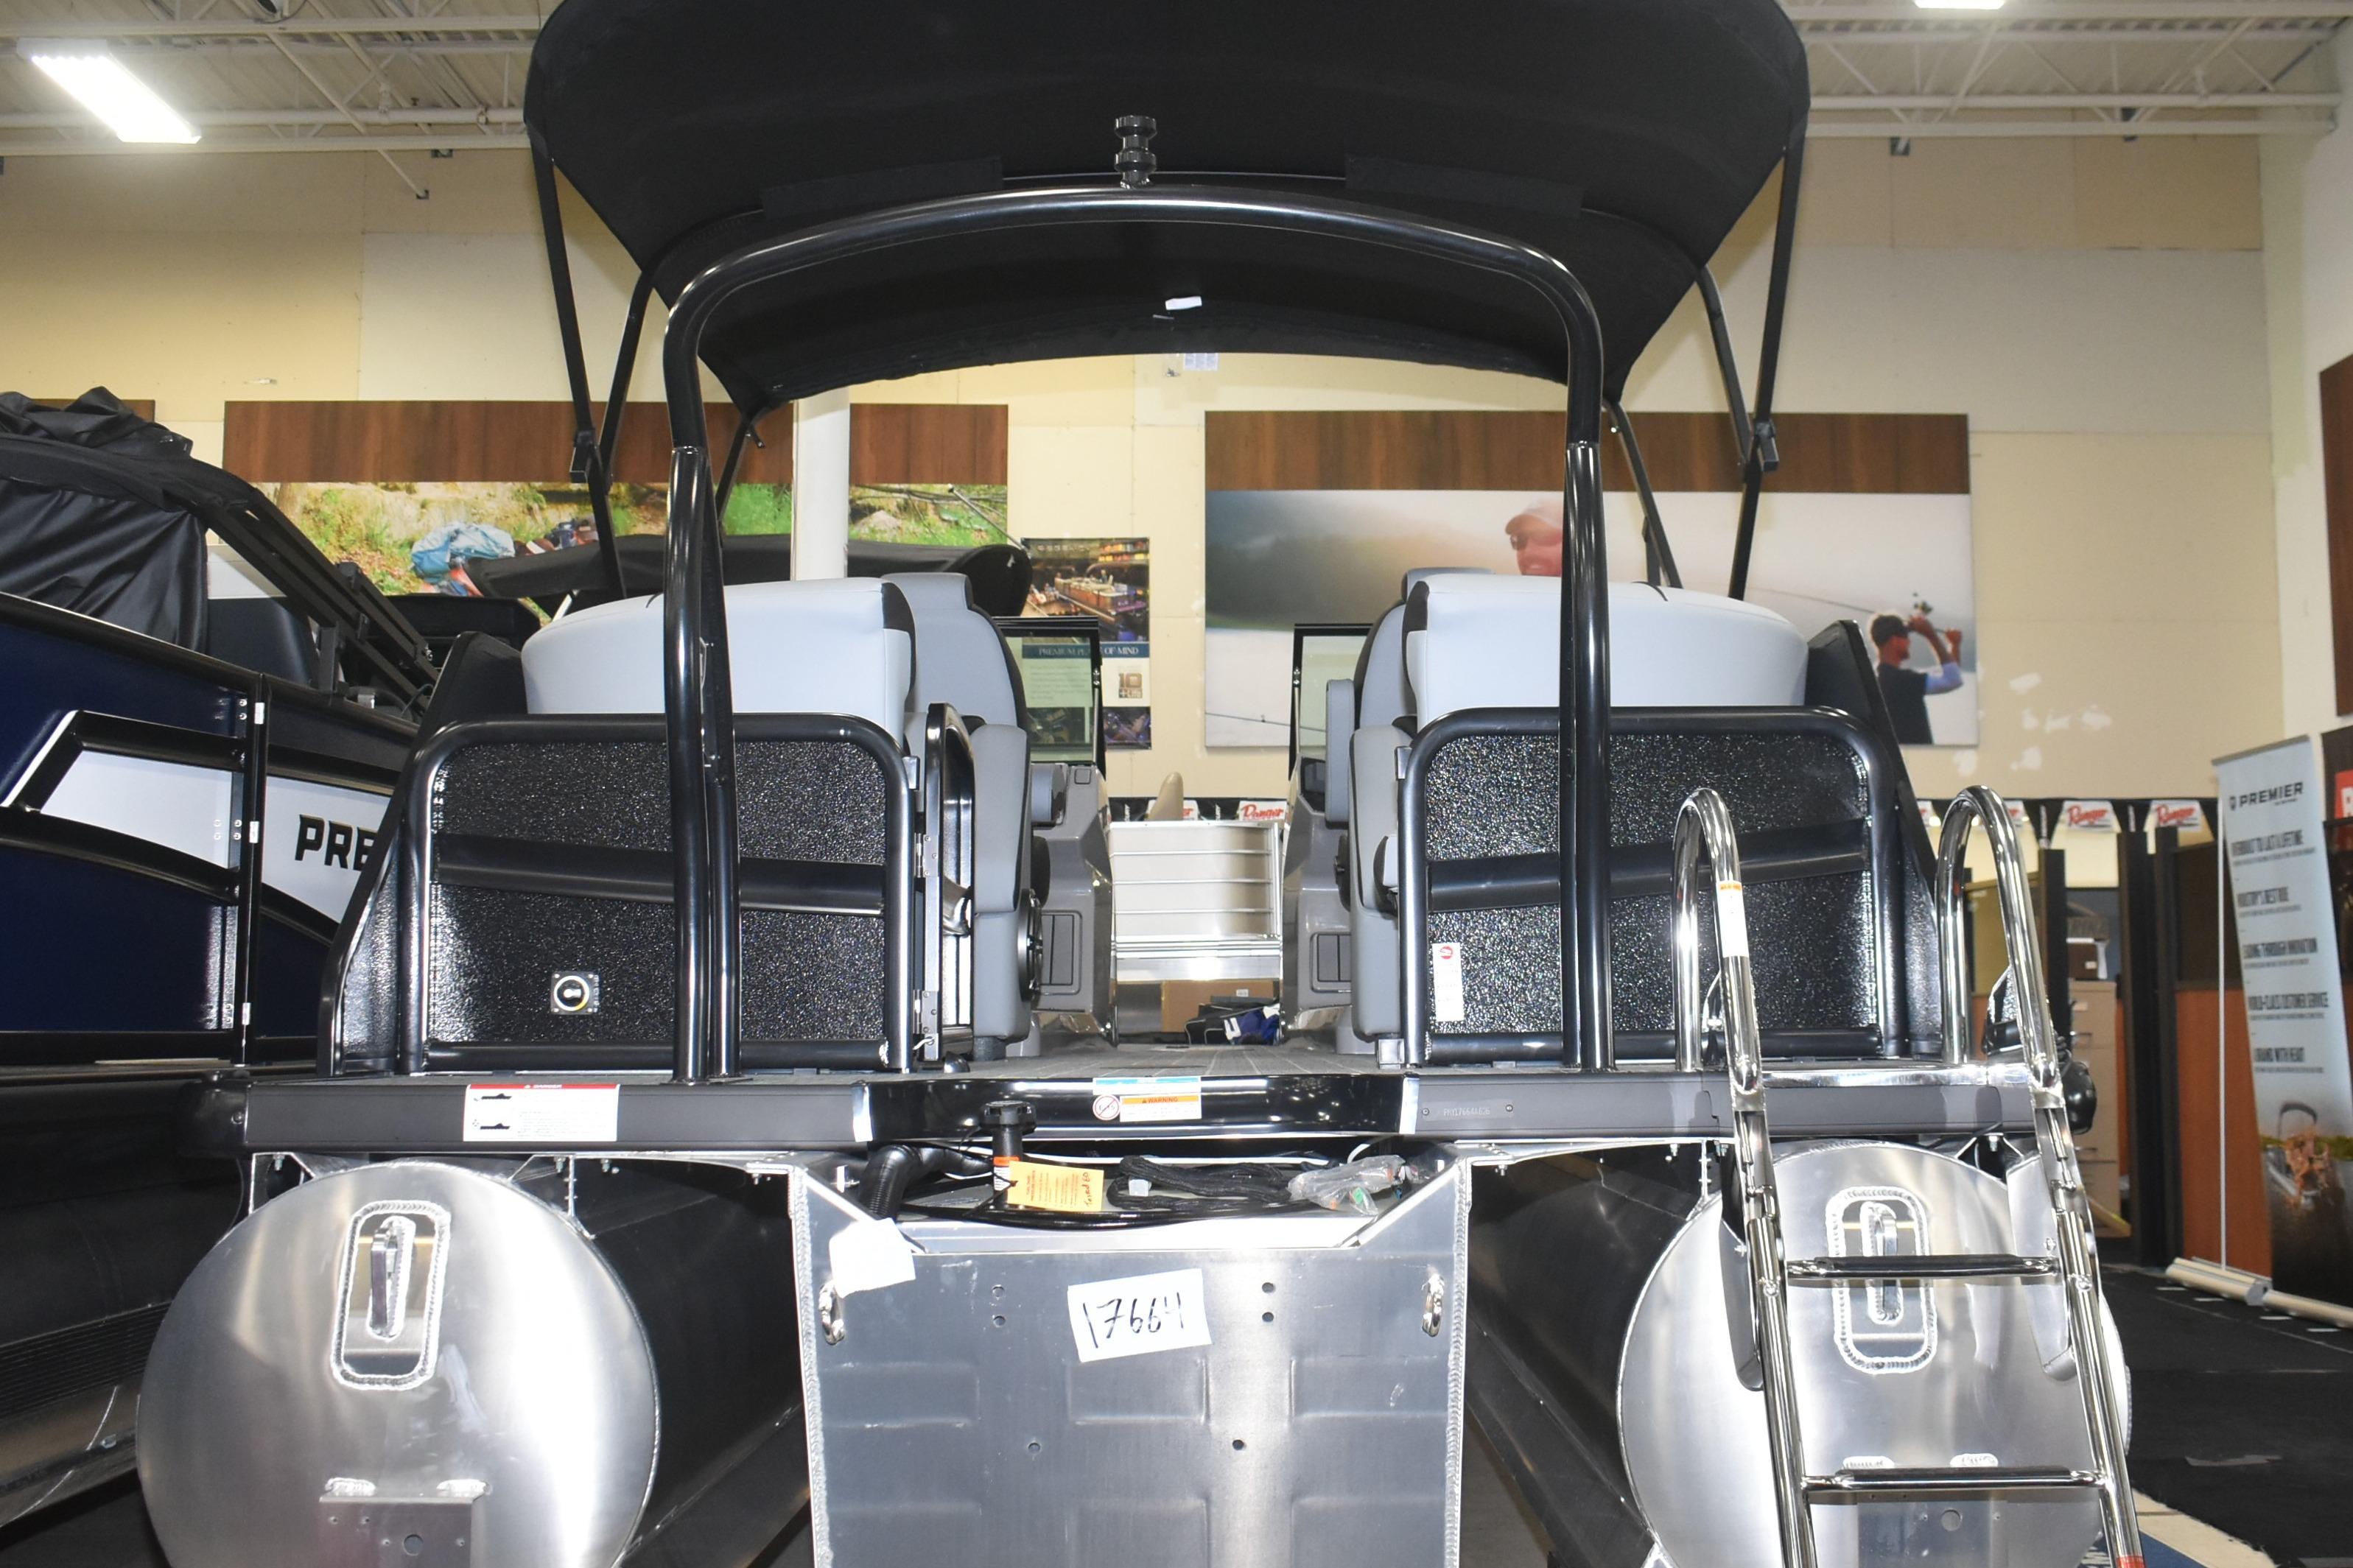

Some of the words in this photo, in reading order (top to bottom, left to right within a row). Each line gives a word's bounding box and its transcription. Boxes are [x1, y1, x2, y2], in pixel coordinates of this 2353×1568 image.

[1118, 647, 1139, 655] MIND
[2239, 781, 2304, 808] PREMIER
[1148, 1096, 1179, 1104] WARNING
[1082, 1291, 1185, 1349] 17664
